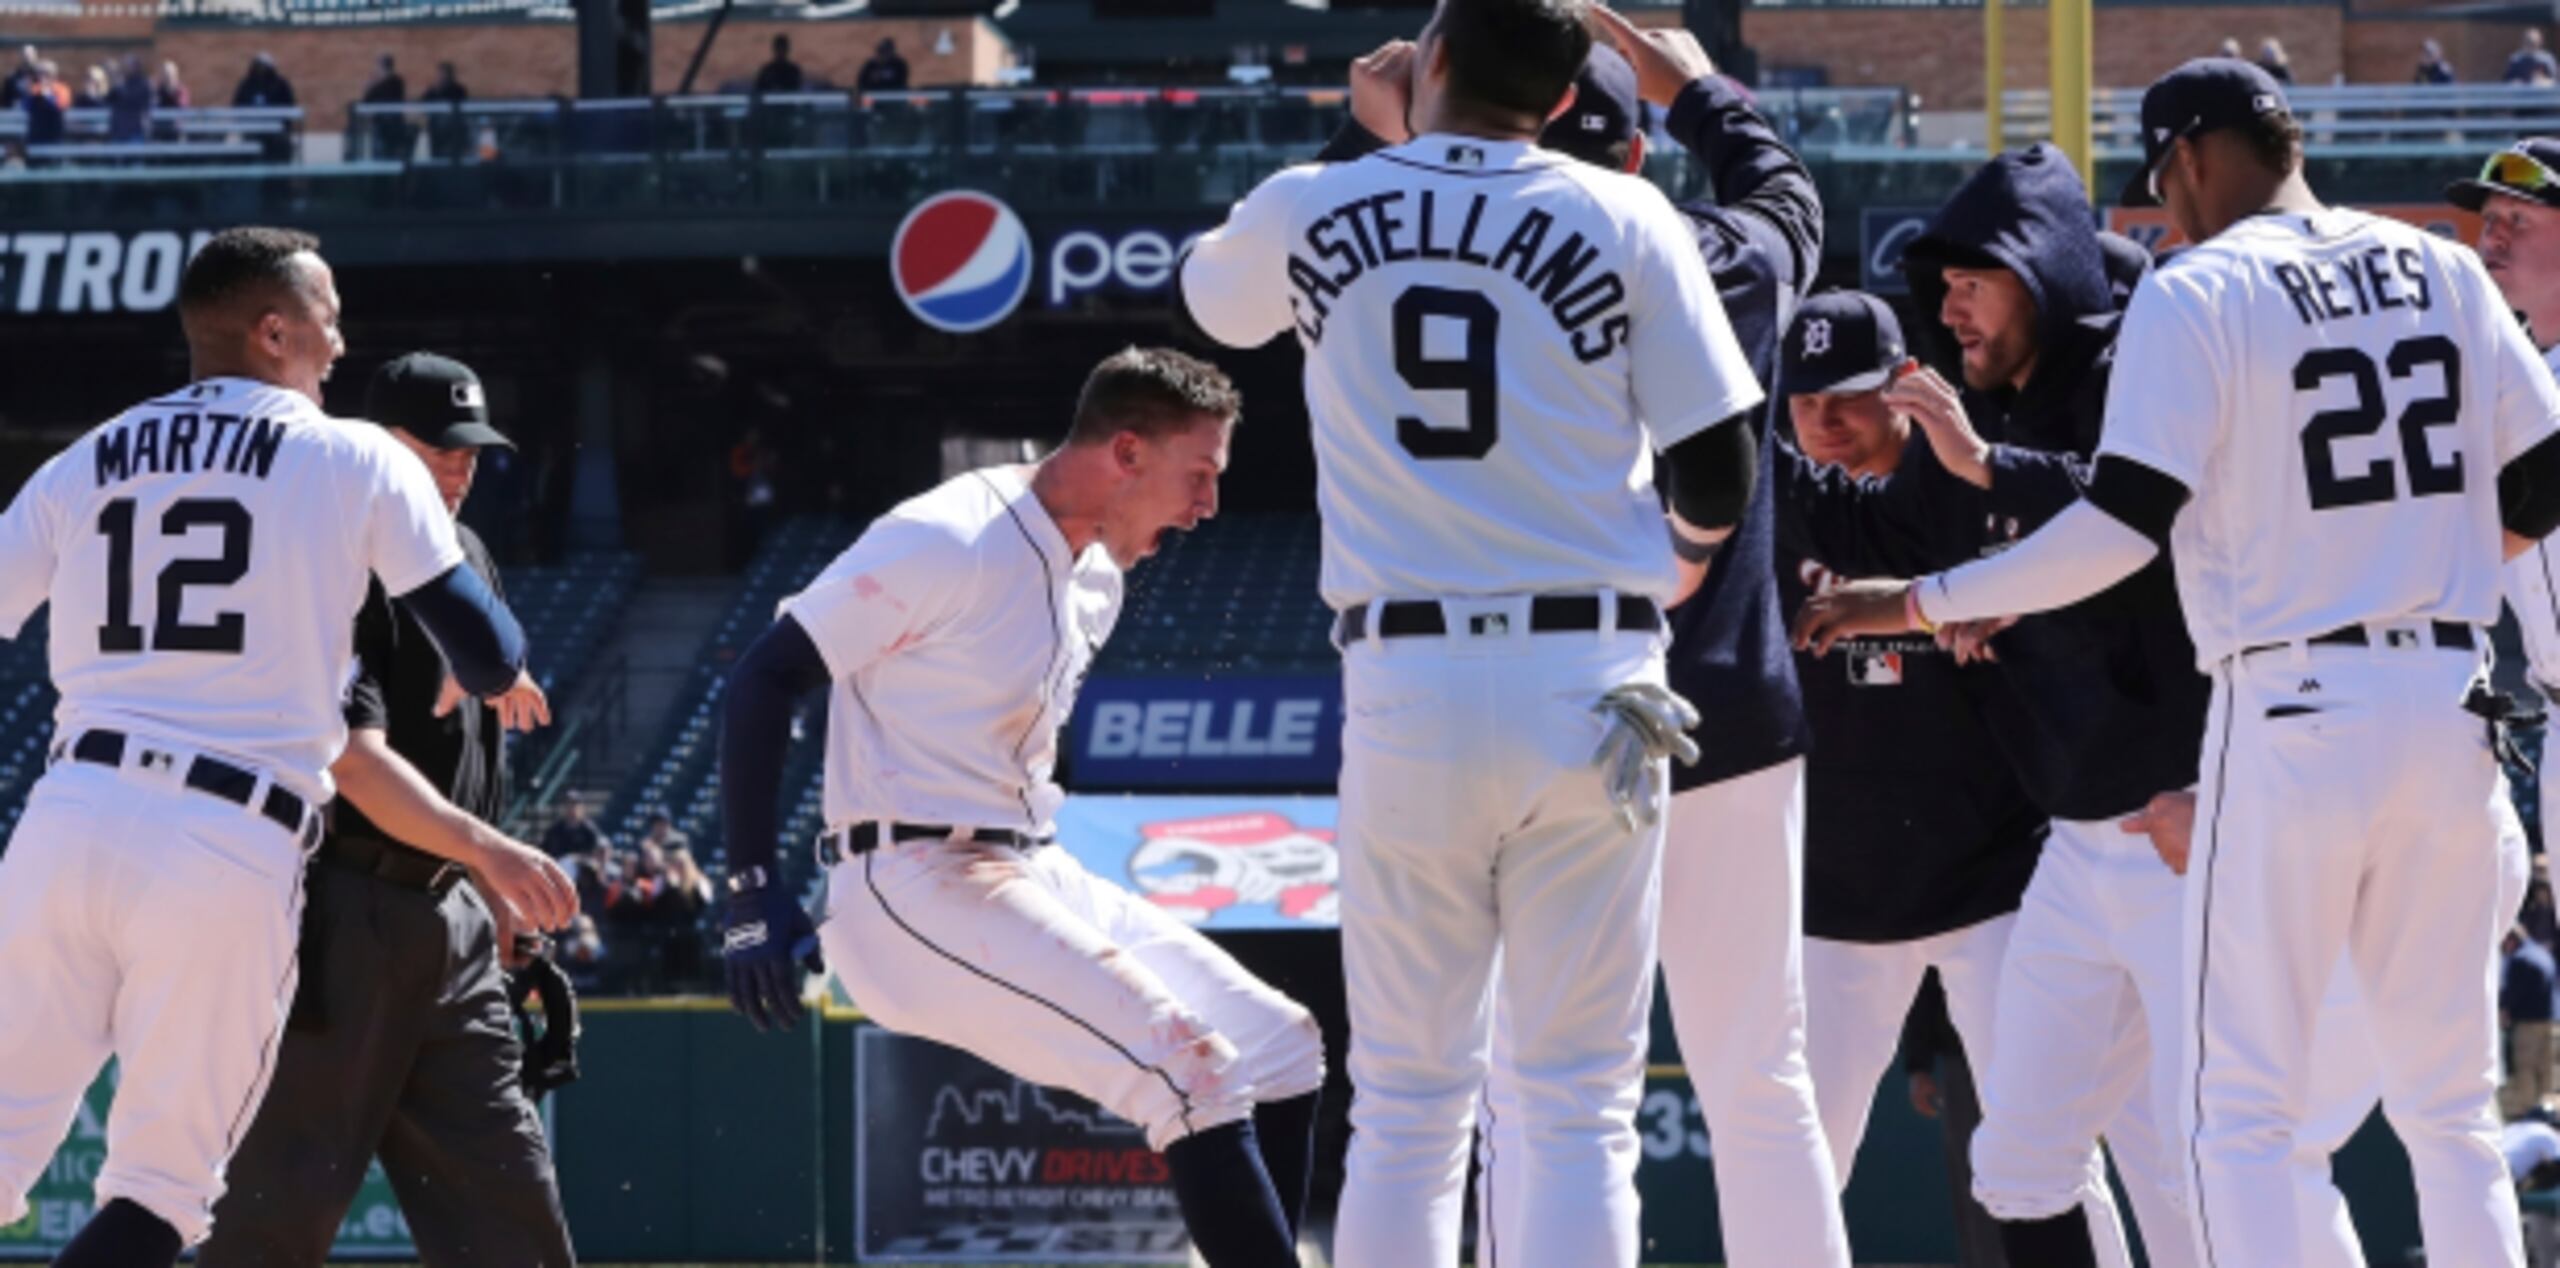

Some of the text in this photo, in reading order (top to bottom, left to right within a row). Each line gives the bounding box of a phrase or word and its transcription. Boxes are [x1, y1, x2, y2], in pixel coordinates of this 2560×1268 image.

[1052, 231, 1200, 304] pe
[1288, 189, 1630, 364] CASTELLANOS
[2275, 246, 2432, 325] REYES
[1392, 285, 1500, 460] 9
[95, 412, 286, 488] MARTIN
[2292, 335, 2465, 511] 22
[97, 497, 253, 655] 12
[1088, 700, 1323, 758] BELLE
[921, 1147, 1170, 1182] CHEVY DRIVES
